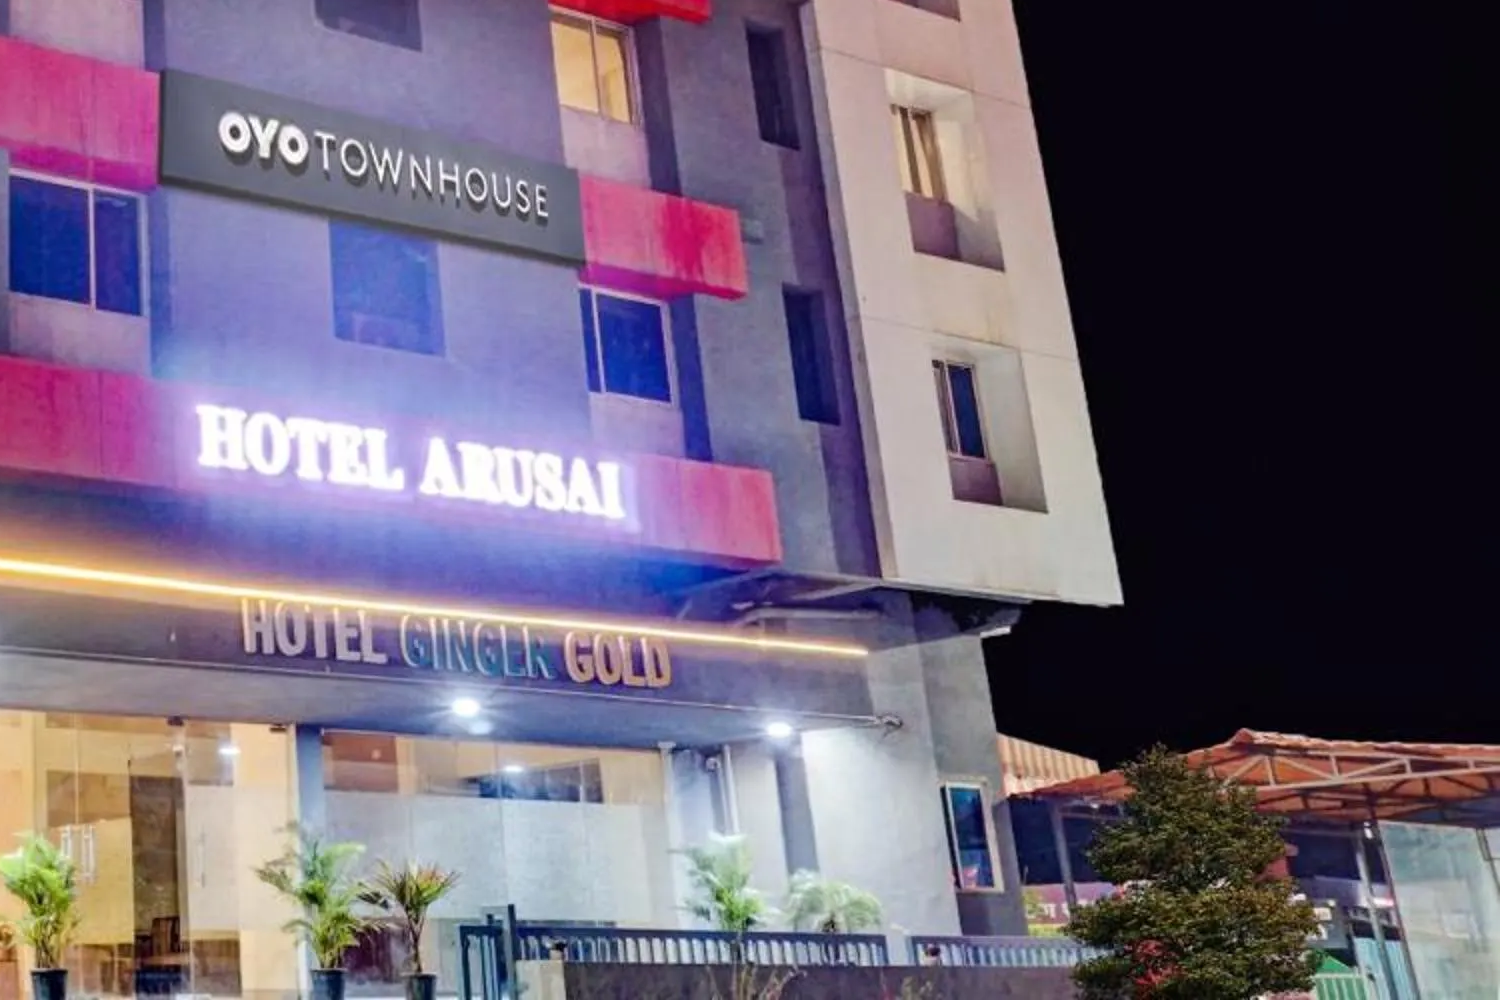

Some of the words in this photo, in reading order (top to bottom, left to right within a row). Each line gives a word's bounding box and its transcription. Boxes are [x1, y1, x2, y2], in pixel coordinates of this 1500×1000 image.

[218, 111, 309, 166] OYO
[313, 130, 549, 217] TOWNHOUSE
[196, 404, 405, 492] HOTEL
[419, 436, 626, 520] ARUSAI
[241, 598, 387, 664] HOTEL
[563, 630, 671, 688] GOLD
